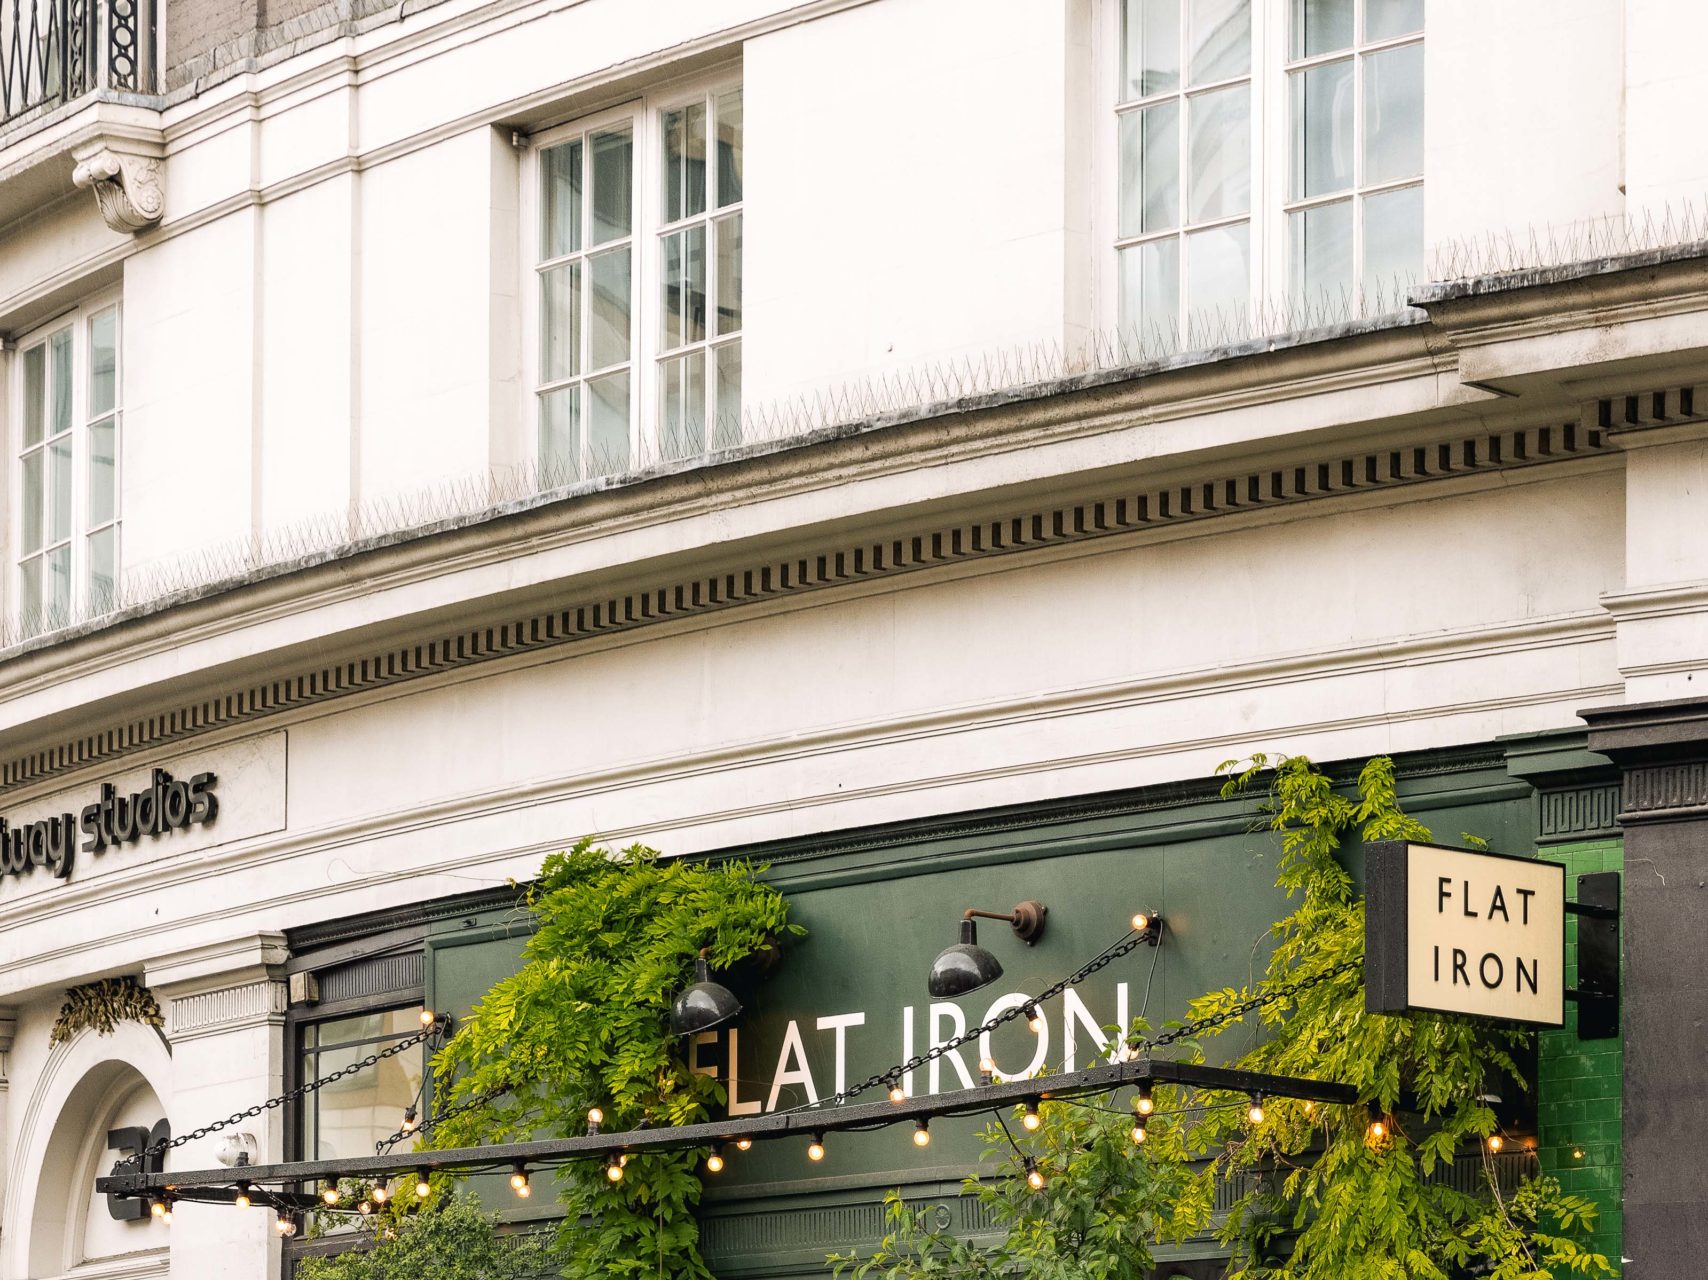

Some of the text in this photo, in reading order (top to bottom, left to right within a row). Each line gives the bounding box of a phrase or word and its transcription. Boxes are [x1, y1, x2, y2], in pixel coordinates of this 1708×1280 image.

[0, 768, 218, 879] way studios
[1438, 876, 1536, 925] FLAT
[1433, 945, 1538, 995] IRON
[689, 982, 1128, 1117] FLAT IRON
